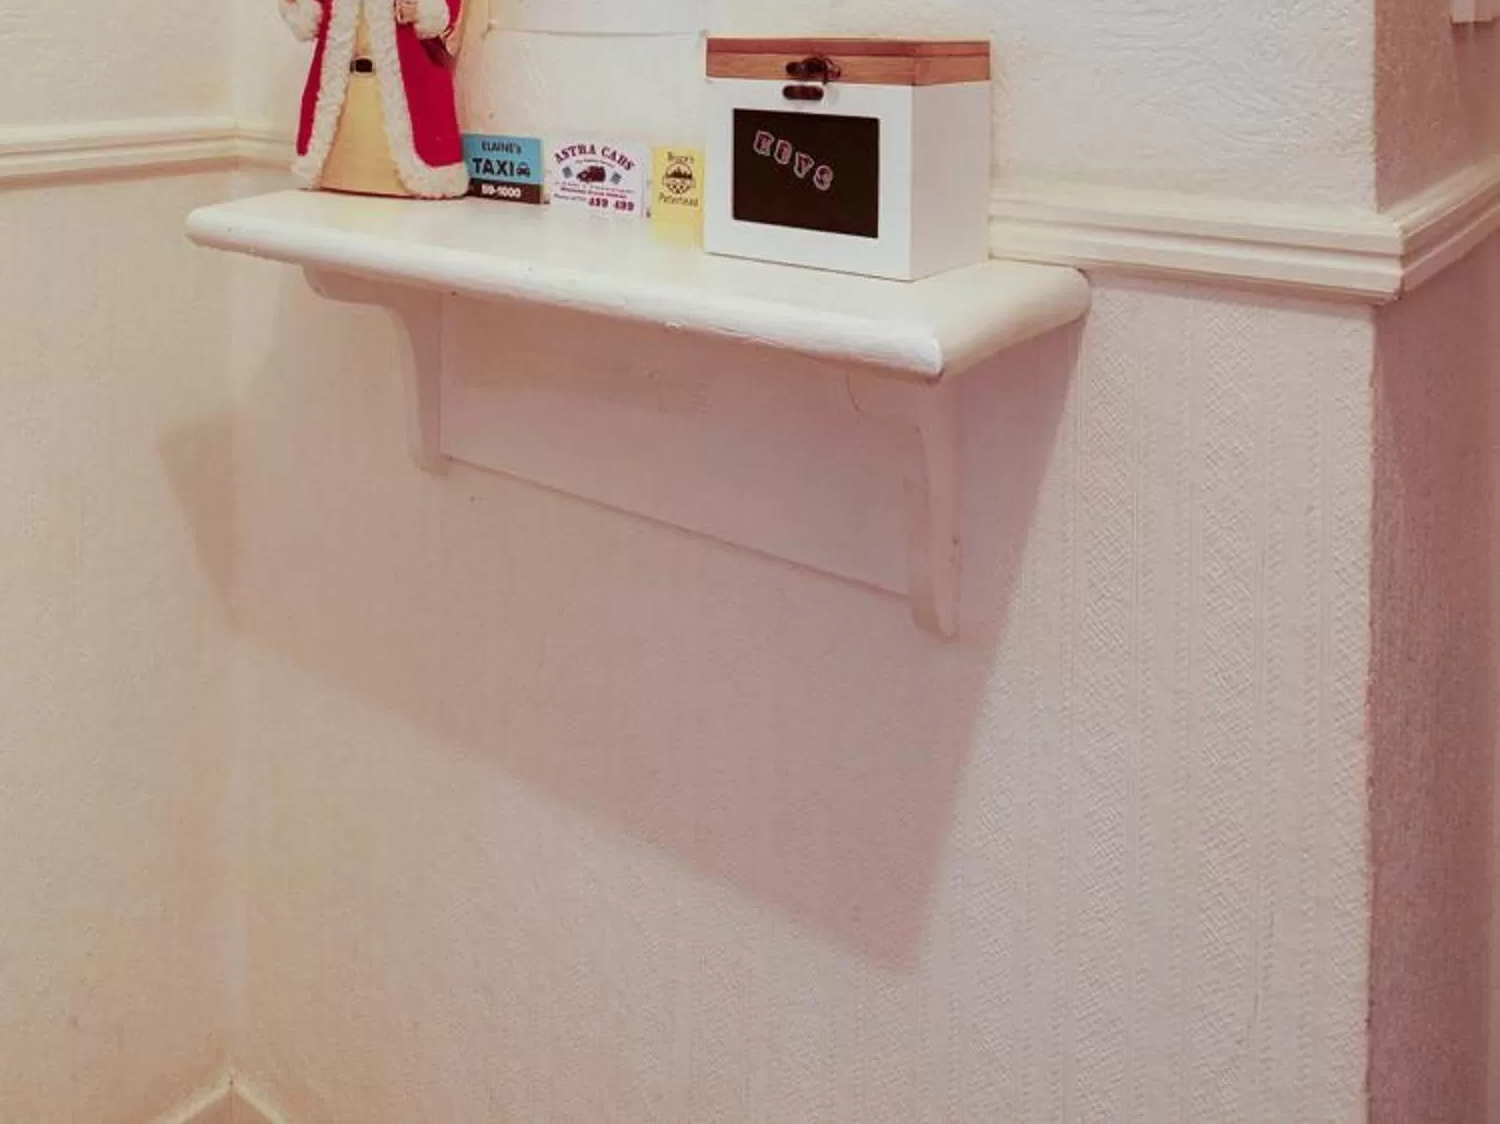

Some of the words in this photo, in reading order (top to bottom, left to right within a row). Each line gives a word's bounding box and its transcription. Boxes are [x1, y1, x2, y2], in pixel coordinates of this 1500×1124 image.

[471, 157, 514, 177] TAXI
[554, 144, 597, 165] ASTRA
[601, 146, 635, 171] CABS
